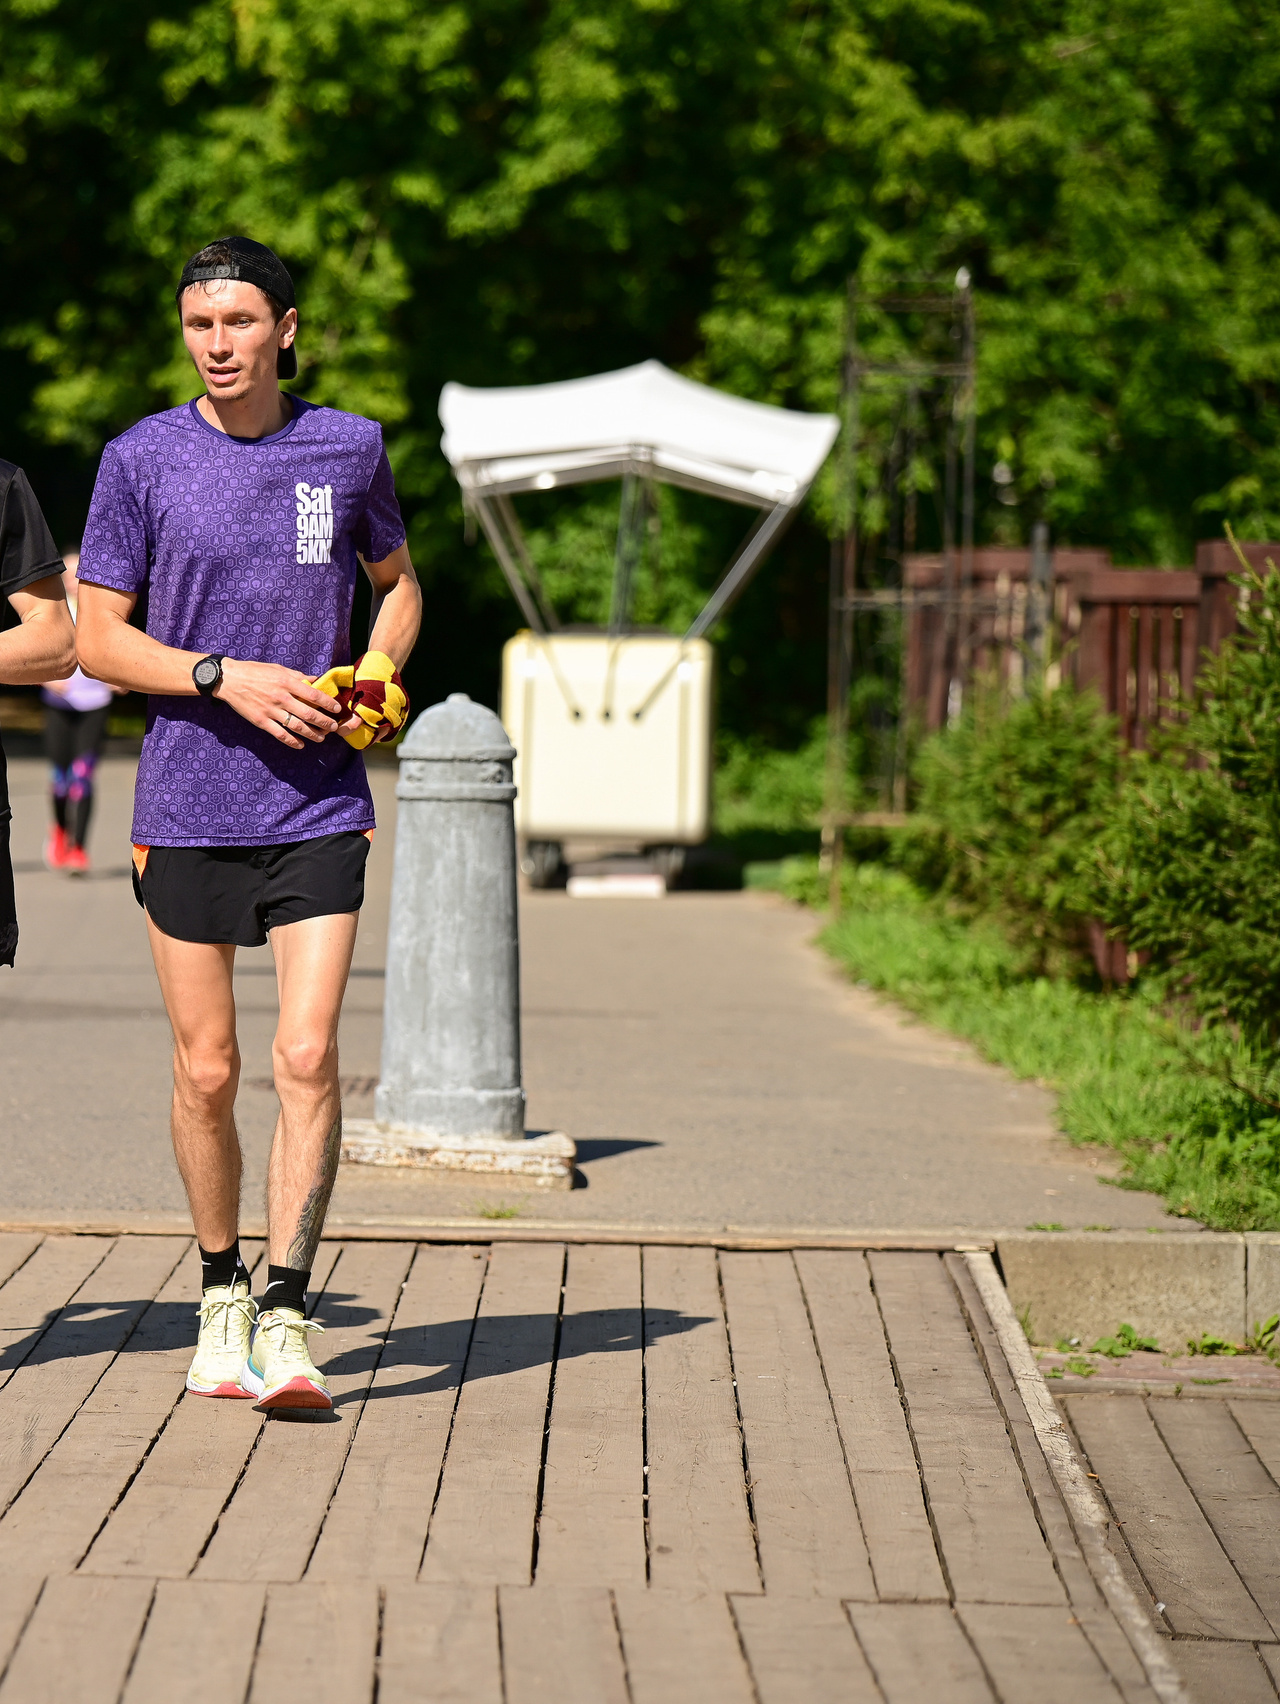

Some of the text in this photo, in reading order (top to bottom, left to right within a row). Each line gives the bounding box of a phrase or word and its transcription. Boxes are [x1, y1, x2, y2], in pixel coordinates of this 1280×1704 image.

[295, 482, 334, 515] Sat
[296, 514, 334, 539] 9AM
[296, 538, 333, 565] 5KM
